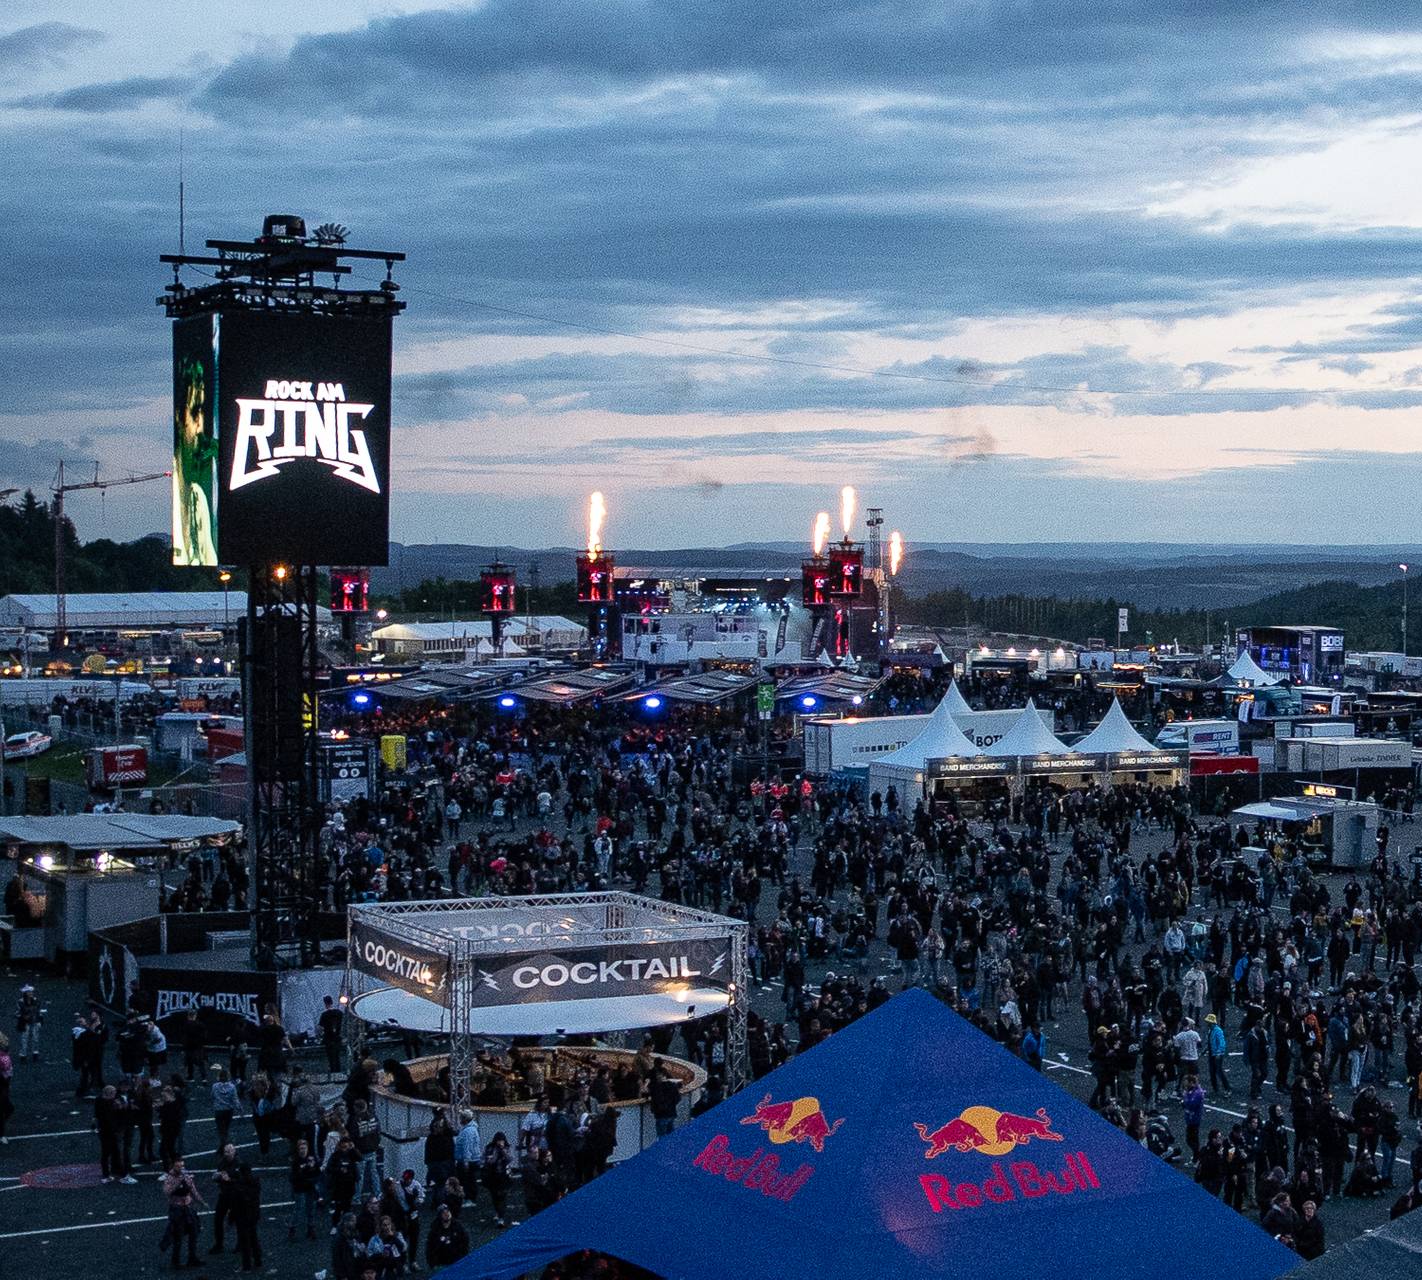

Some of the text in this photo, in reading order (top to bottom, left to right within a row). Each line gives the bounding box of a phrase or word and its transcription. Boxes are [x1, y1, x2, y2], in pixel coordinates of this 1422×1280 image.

[265, 380, 345, 401] ROCK AM
[229, 399, 380, 494] RING
[976, 734, 1003, 747] BOT
[940, 763, 1006, 772] BAND MERCHANDISE
[1051, 760, 1096, 768] MERCHANDISE
[1119, 756, 1180, 765] BAND MERCHANDISE
[365, 941, 436, 987] COCKTAIL
[512, 956, 700, 989] COCKTAIL
[156, 990, 200, 1020] ROCK
[215, 992, 260, 1026] RING
[694, 1135, 814, 1201] Red Bull
[919, 1151, 1101, 1212] Red Bull
